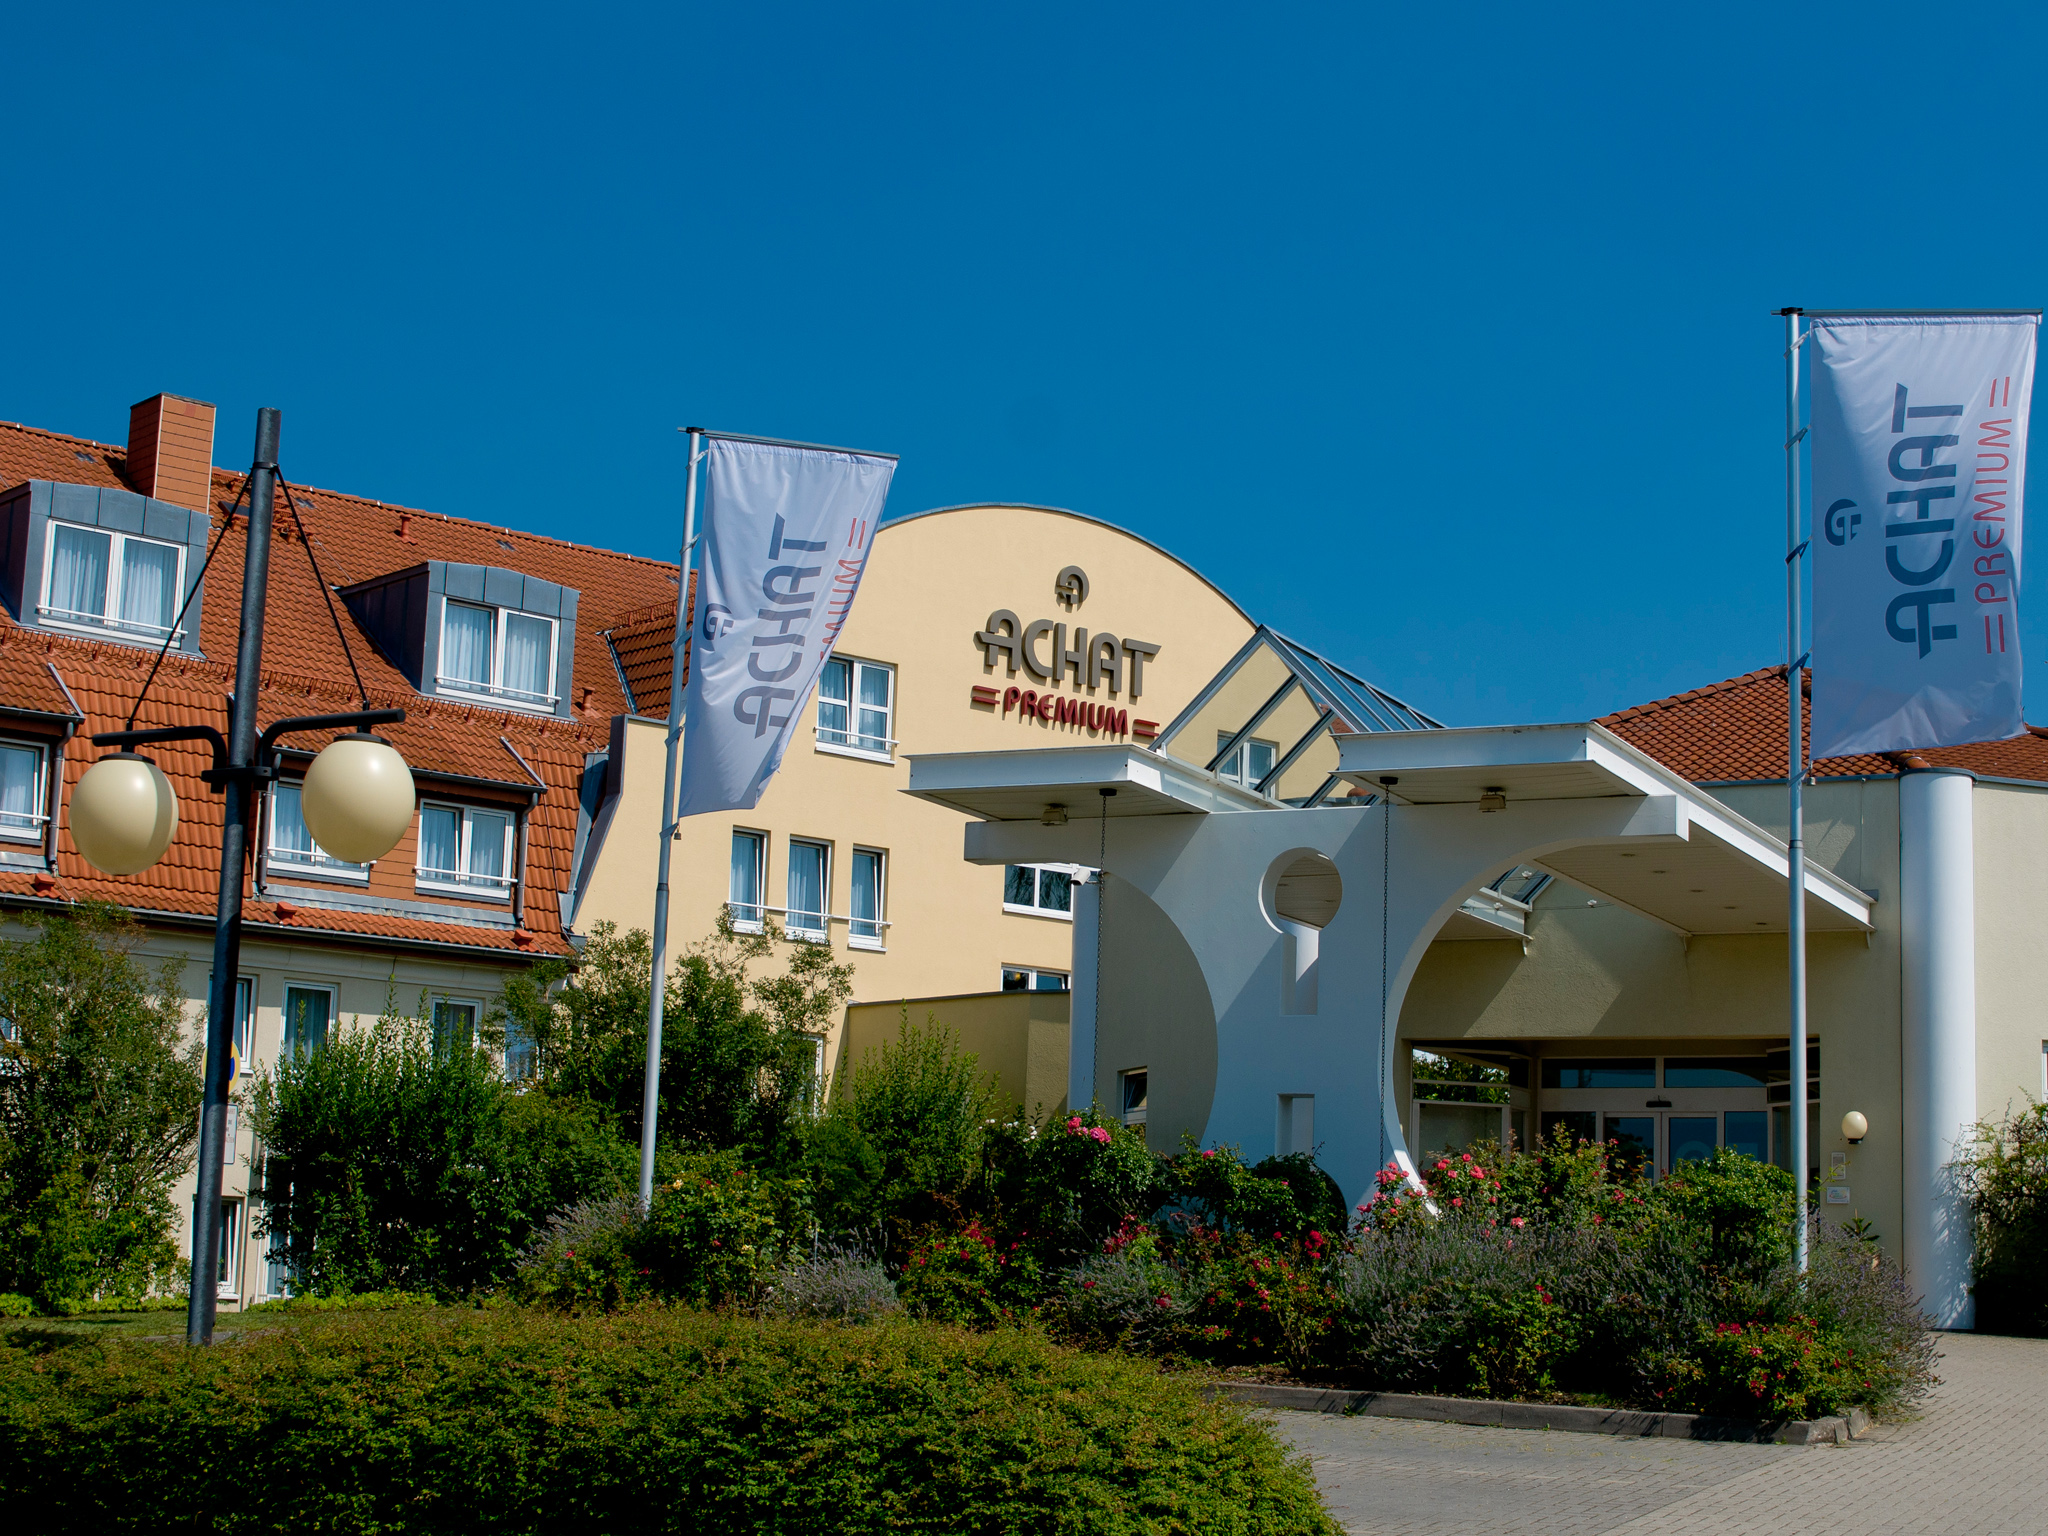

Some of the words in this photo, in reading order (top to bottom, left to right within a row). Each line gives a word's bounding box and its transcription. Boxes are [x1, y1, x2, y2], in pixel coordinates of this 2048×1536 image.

[1885, 382, 1963, 659] ACHAT
[1972, 418, 2013, 604] PREMIUM
[734, 512, 827, 739] ACHAT
[820, 558, 863, 660] MIUM
[975, 608, 1162, 697] ACHAT
[1003, 686, 1129, 736] PREMIUM
